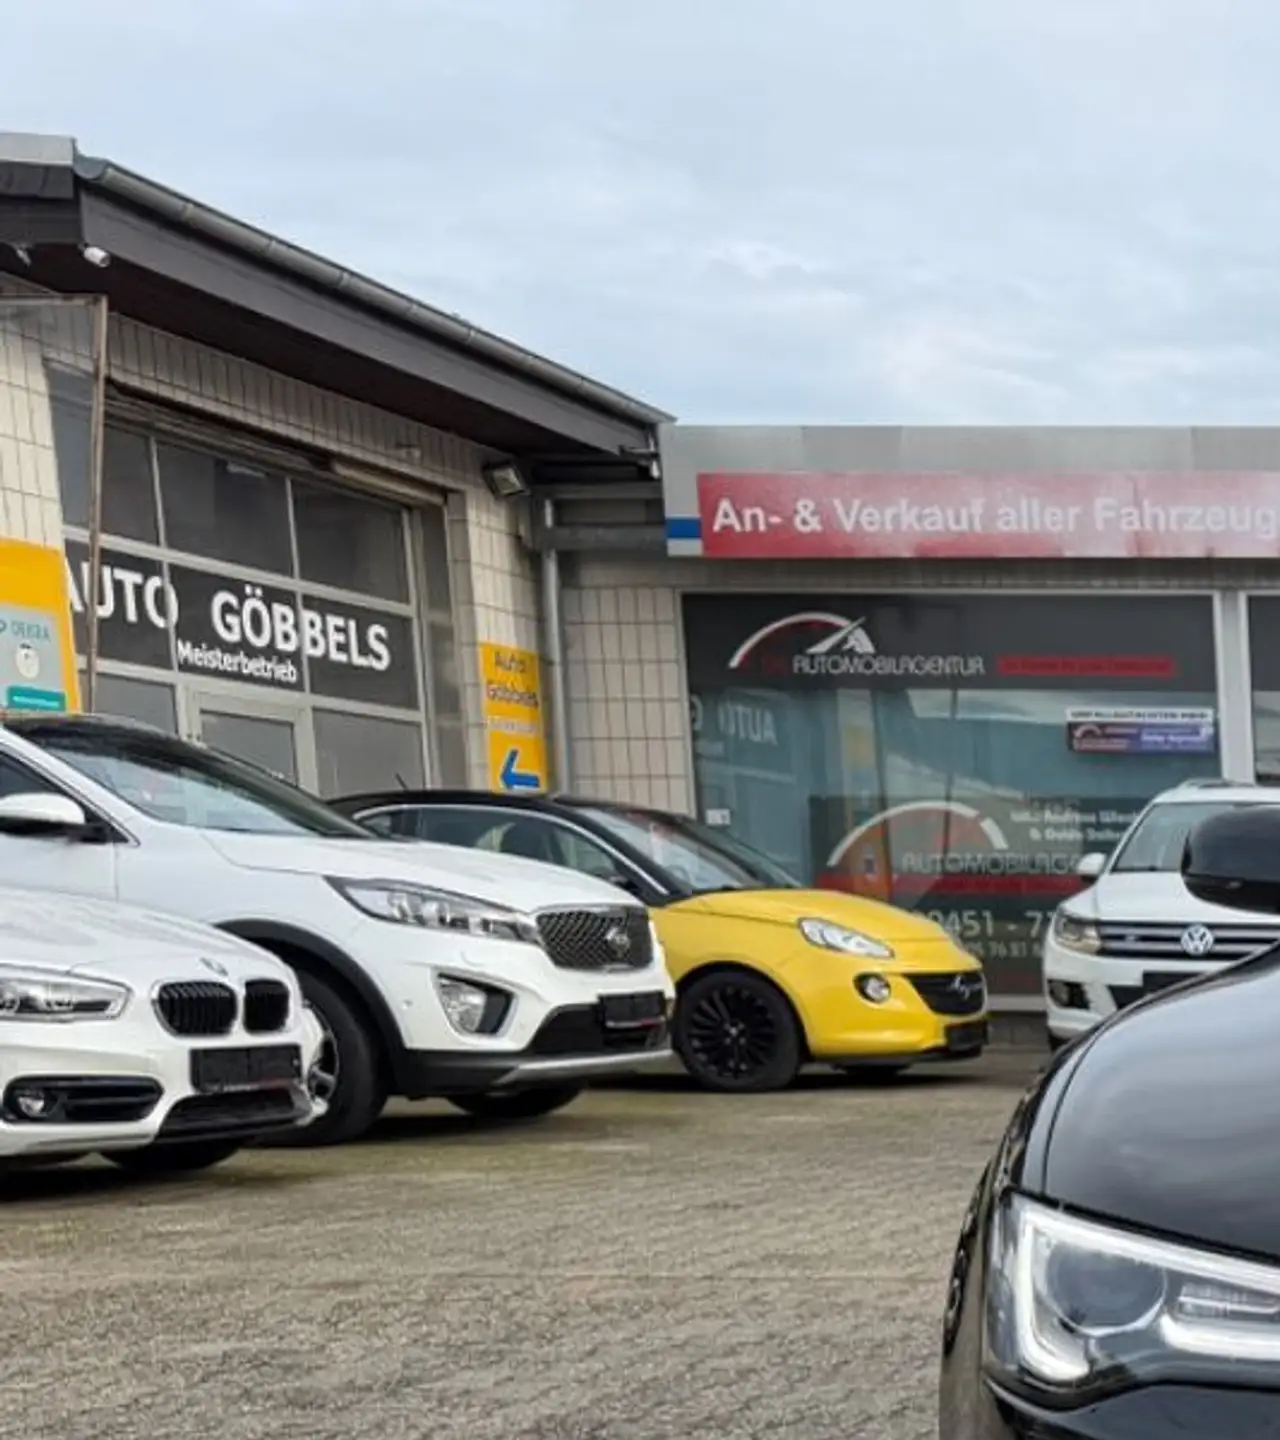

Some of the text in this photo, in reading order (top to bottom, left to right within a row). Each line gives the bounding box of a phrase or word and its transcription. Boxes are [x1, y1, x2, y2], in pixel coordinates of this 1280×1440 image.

[712, 498, 784, 533] An-
[793, 498, 823, 533] &
[832, 498, 987, 533] Verkauf
[996, 499, 1082, 533] aller
[211, 585, 391, 672] GÖBBELS
[177, 640, 297, 684] Meisterbetrieb
[792, 655, 986, 675] AUTOMOBILAGENTUR
